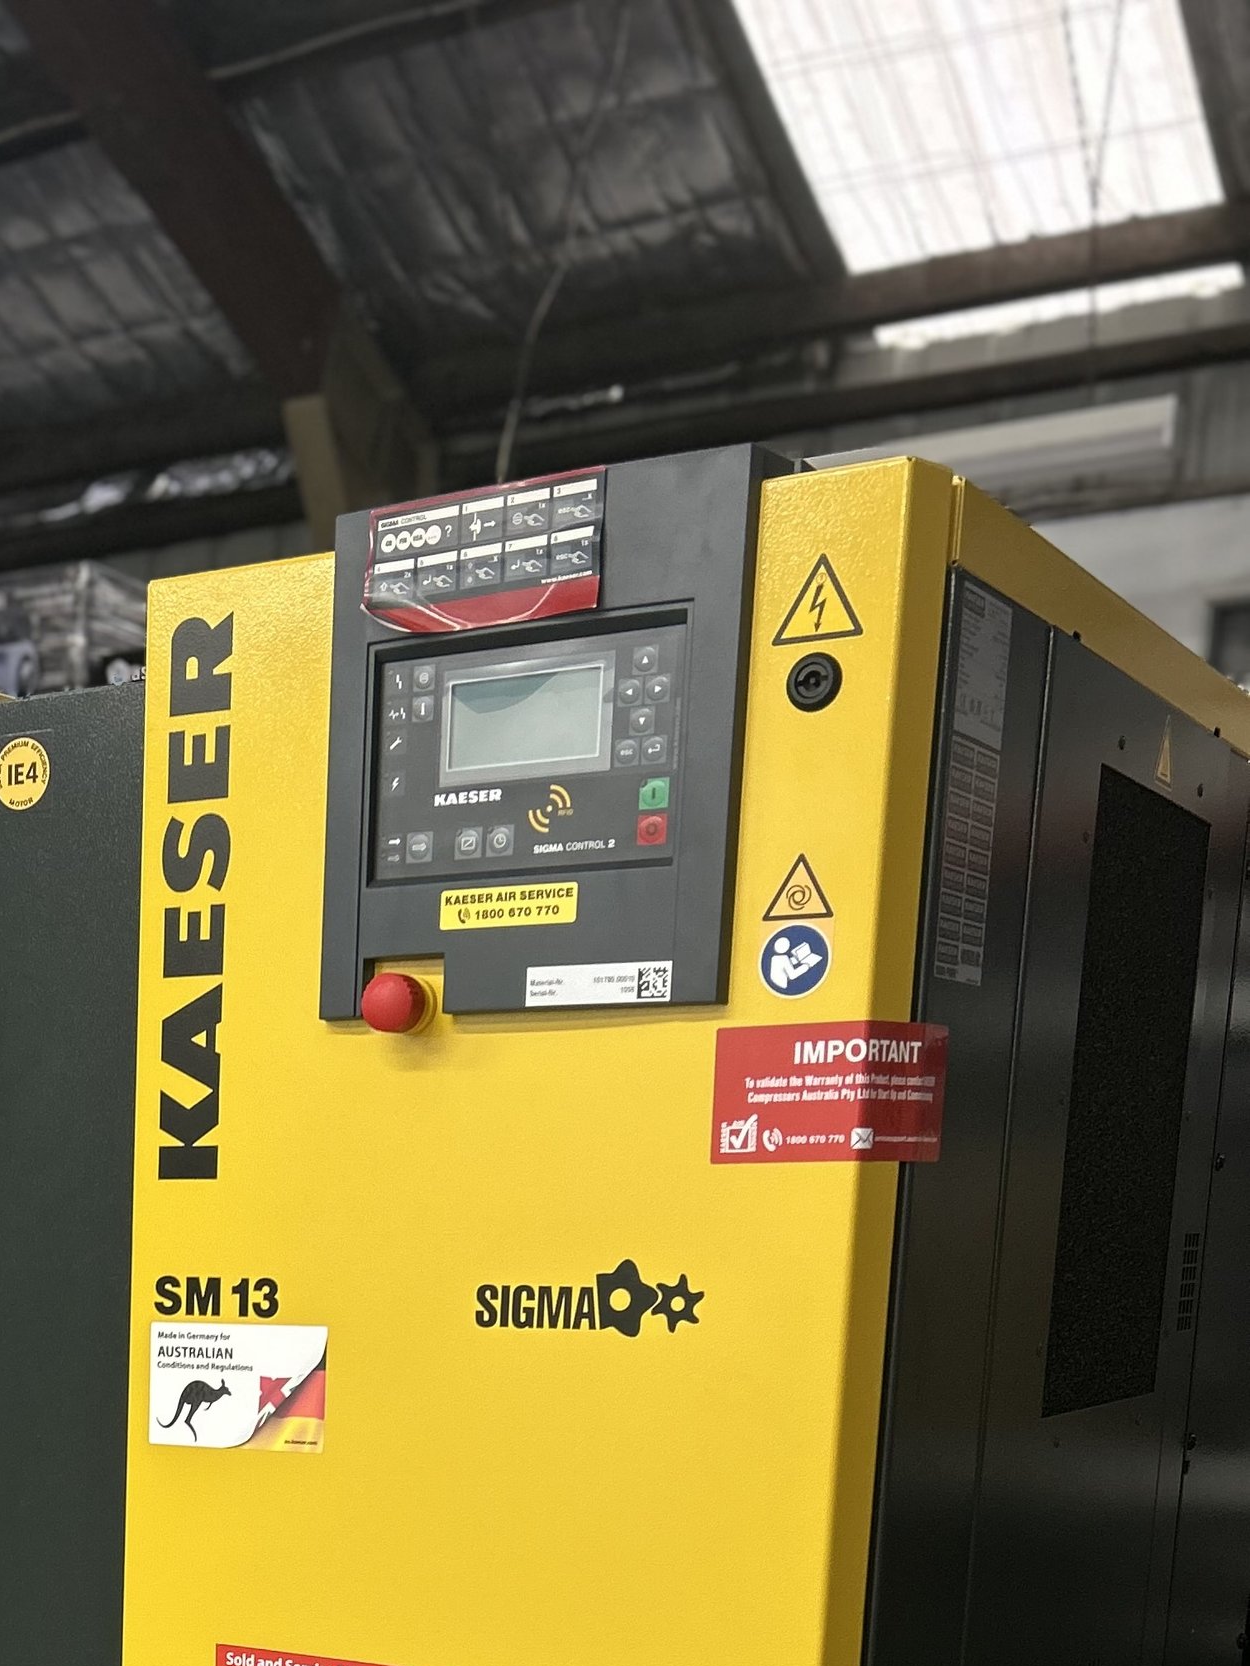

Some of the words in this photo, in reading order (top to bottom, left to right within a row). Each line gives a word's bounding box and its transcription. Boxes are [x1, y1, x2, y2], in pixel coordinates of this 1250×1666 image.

[8, 762, 38, 786] IE4
[9, 797, 33, 807] MOTOR
[434, 788, 502, 807] KAESER
[533, 842, 564, 854] SIGMA
[566, 840, 606, 852] CONTROL
[608, 839, 616, 849] 2
[158, 611, 234, 1180] KAESER
[445, 892, 493, 906] KAESER
[495, 890, 517, 902] AIR
[520, 887, 574, 901] SERVICE
[475, 907, 504, 920] 1800
[508, 906, 532, 917] 670
[536, 905, 560, 916] 770
[794, 1038, 922, 1064] IMPORTANT
[756, 1076, 787, 1088] validate
[789, 1075, 803, 1087] the
[805, 1074, 843, 1088] Warranty
[748, 1091, 800, 1104] Compressors
[801, 1089, 839, 1102] Australia
[841, 1088, 855, 1102] Pty
[154, 1276, 221, 1318] SM
[231, 1277, 279, 1318] 13
[475, 1284, 597, 1331] SIGMA
[158, 1331, 177, 1339] Made
[178, 1332, 185, 1340] in
[187, 1332, 218, 1342] Germany
[220, 1333, 231, 1341] for
[157, 1346, 233, 1360] AUSTRALIAN
[157, 1361, 195, 1370] Conditions
[196, 1362, 210, 1370] and
[211, 1363, 253, 1372] Regulations
